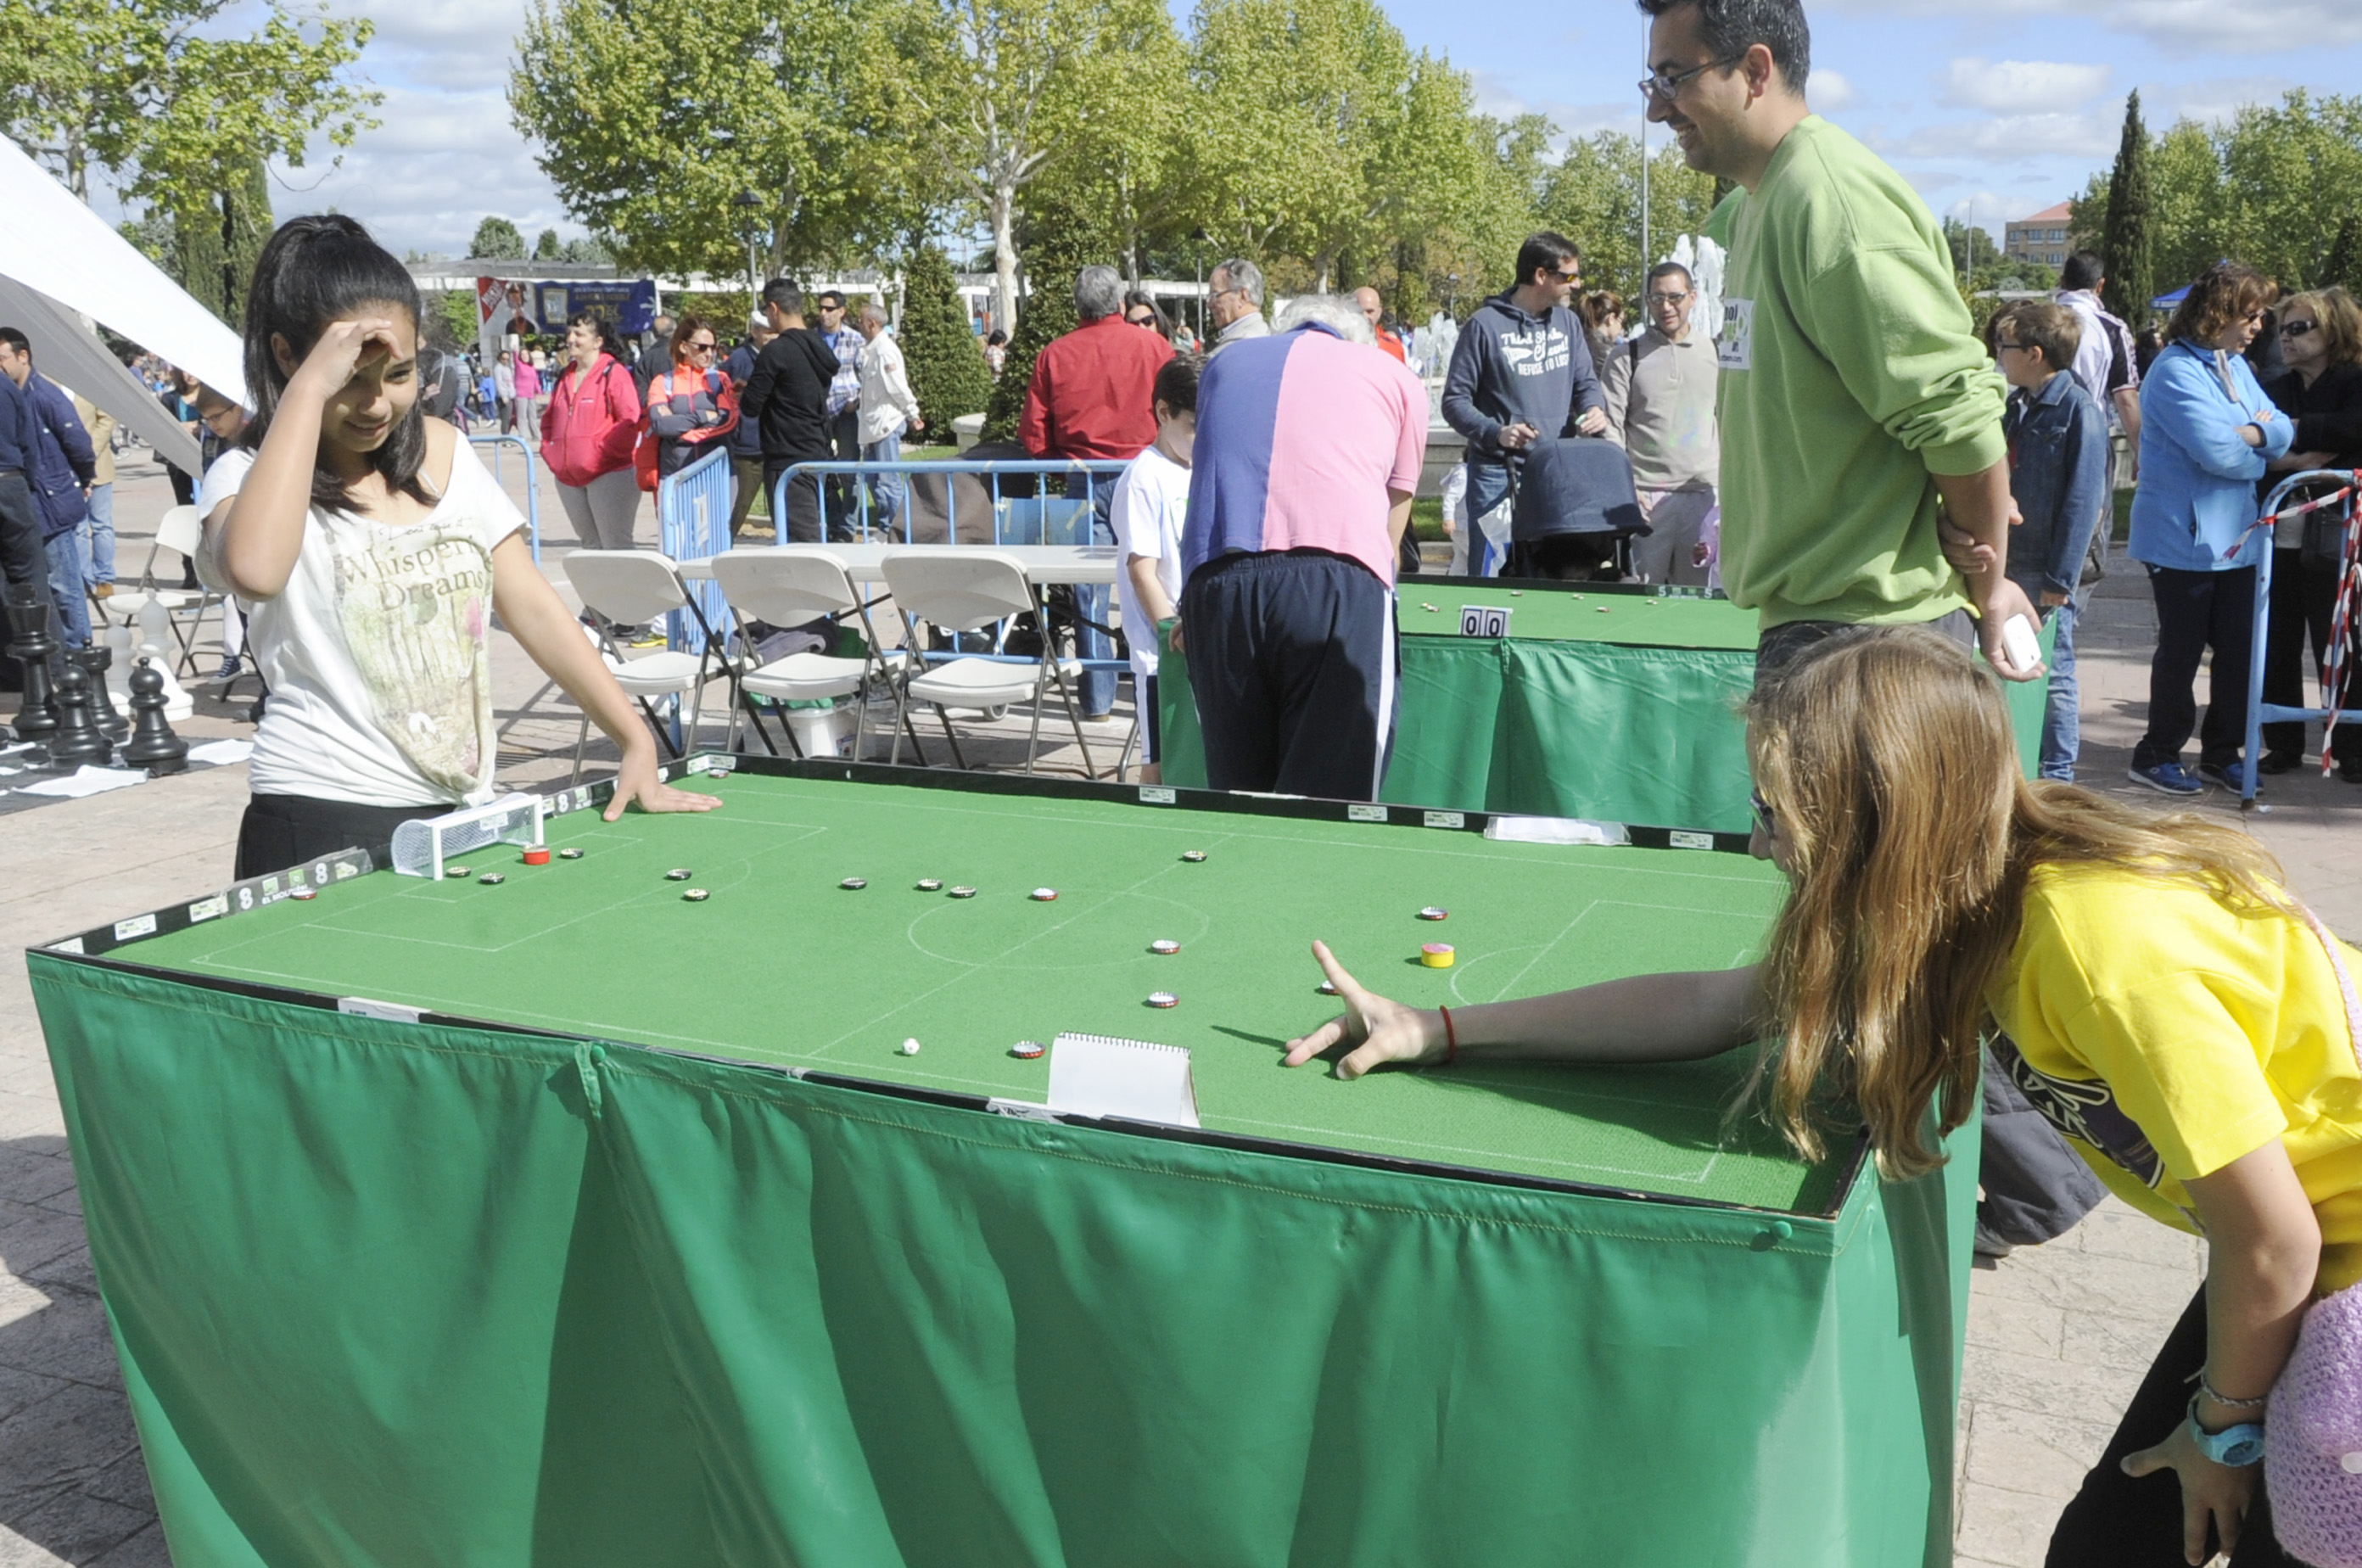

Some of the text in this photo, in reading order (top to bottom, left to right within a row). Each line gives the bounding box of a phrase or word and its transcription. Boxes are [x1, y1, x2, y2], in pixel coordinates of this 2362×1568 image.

[1518, 361, 1544, 376] REFUSE
[1544, 357, 1555, 372] TO
[379, 568, 484, 611] Dreams
[1658, 585, 1667, 598] 5
[1704, 588, 1713, 599] 5
[1465, 615, 1477, 635] 0
[1489, 618, 1501, 636] 0
[557, 793, 569, 814] 8
[315, 862, 327, 885] 8
[238, 887, 254, 910] 8
